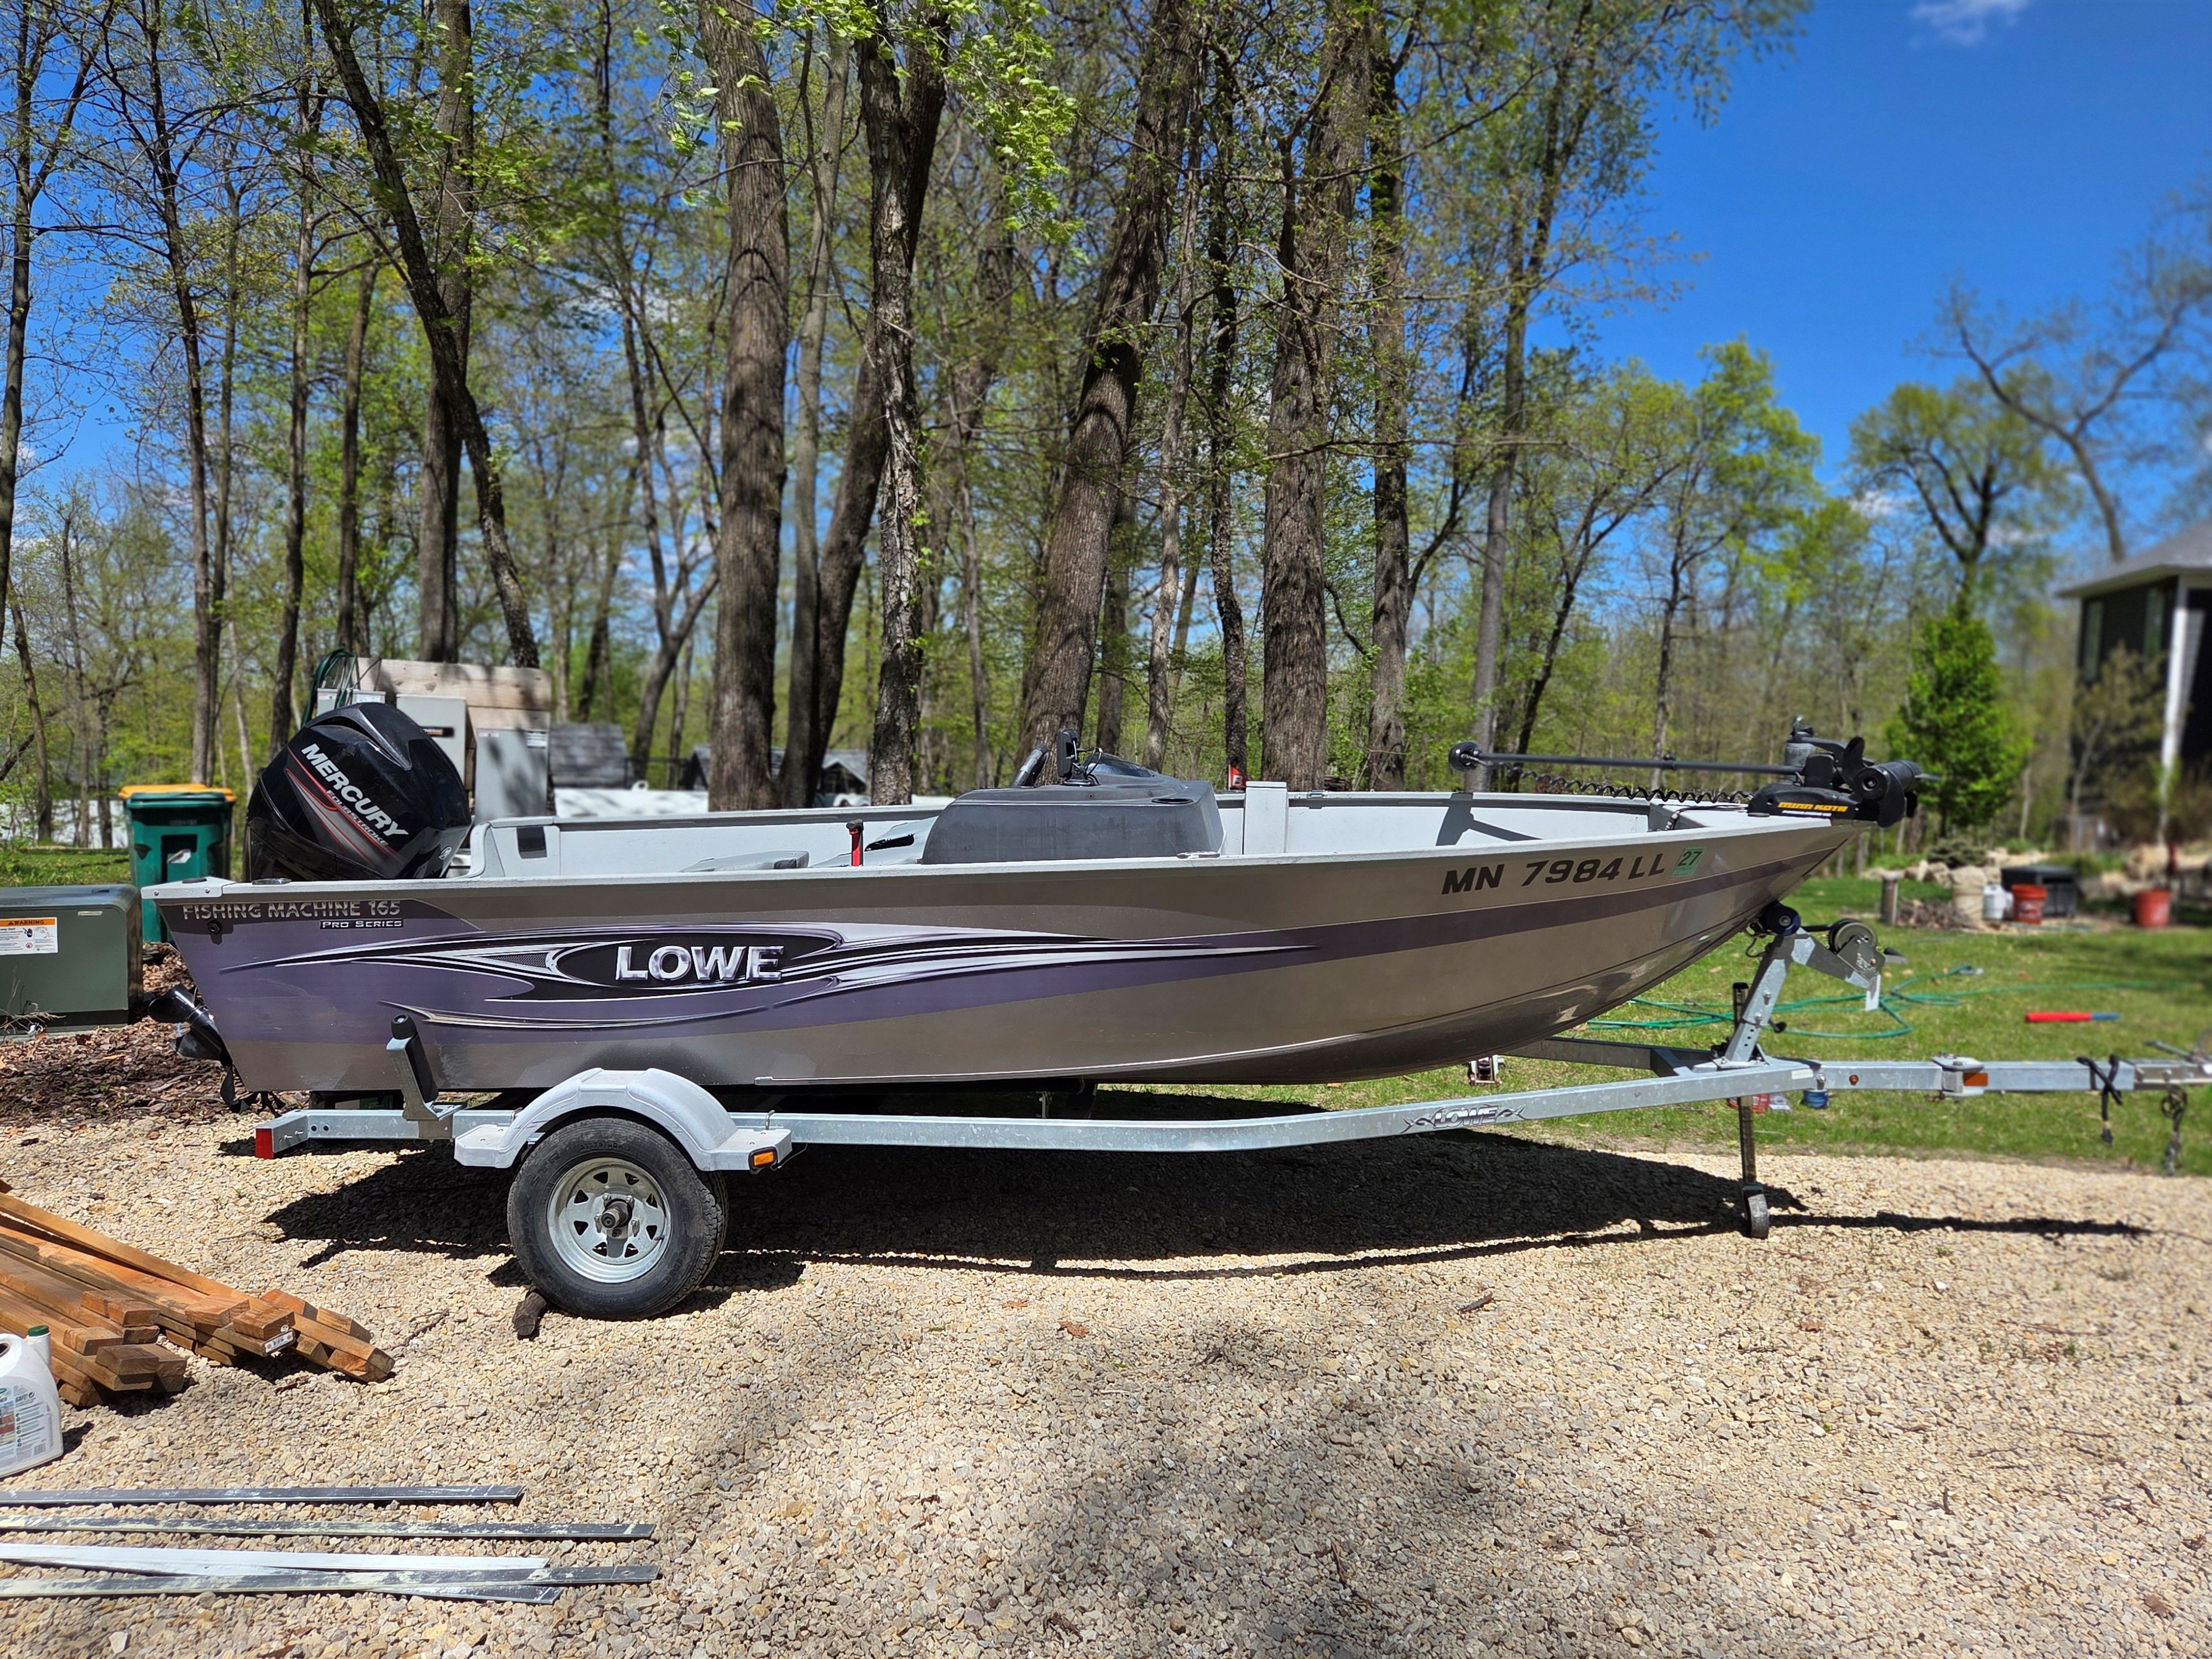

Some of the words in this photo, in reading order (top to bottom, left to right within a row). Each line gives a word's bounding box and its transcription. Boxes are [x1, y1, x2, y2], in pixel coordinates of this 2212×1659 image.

[301, 743, 409, 837] MERCURY
[326, 790, 389, 846] FOURSTROKE
[1441, 864, 1505, 895] MN
[1521, 858, 1624, 886] 7984
[1628, 853, 1665, 880] LL
[1677, 851, 1703, 867] 27
[182, 903, 262, 920] FISHING
[268, 901, 361, 919] MACHINE
[368, 900, 401, 916] 165
[615, 946, 784, 981] LOWE
[1433, 1105, 1499, 1129] LOWE
